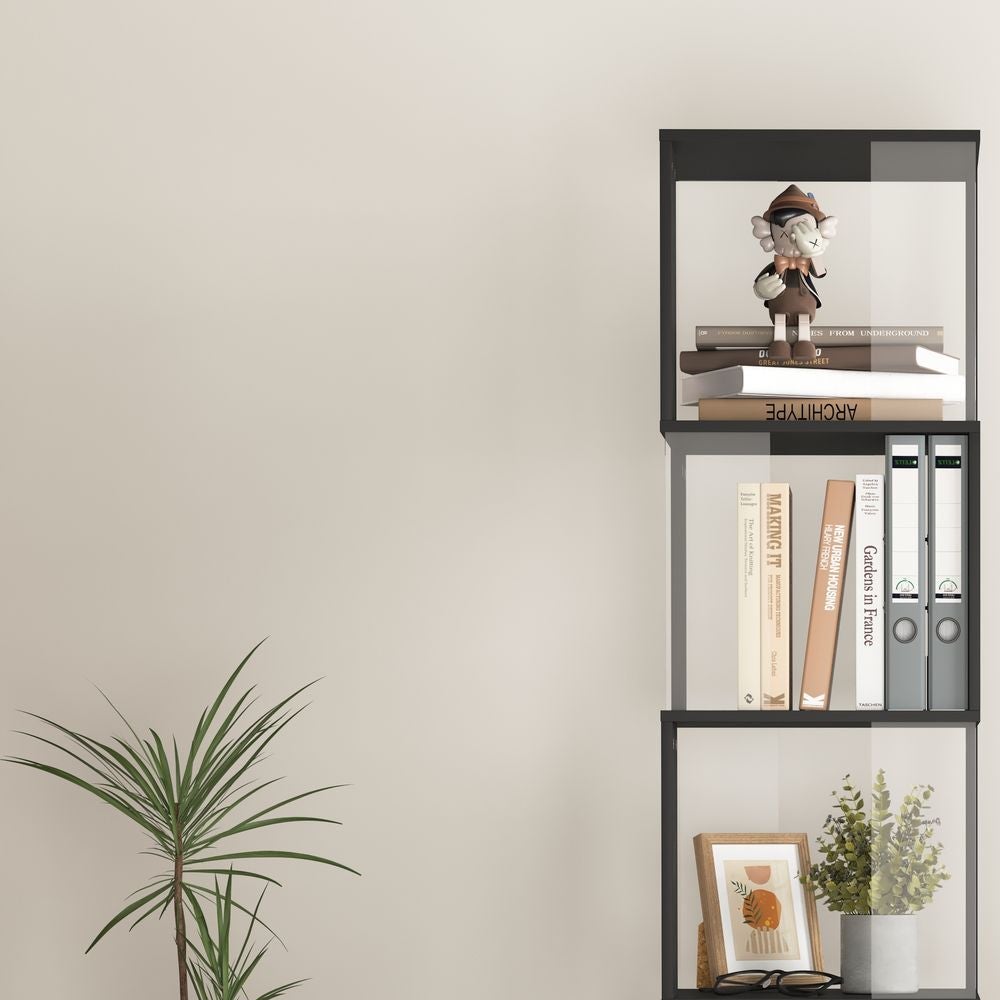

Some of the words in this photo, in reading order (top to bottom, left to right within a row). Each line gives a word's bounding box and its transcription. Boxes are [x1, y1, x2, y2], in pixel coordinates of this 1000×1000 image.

[766, 403, 857, 421] ARCHITYPE
[766, 493, 782, 550] MAKING
[833, 525, 845, 543] NEW
[823, 524, 833, 545] HILARY
[766, 554, 782, 568] IT
[829, 545, 843, 574] URBAN
[864, 545, 878, 592] Gardens
[824, 574, 839, 611] HOUSING
[864, 594, 878, 606] in
[864, 608, 878, 647] France
